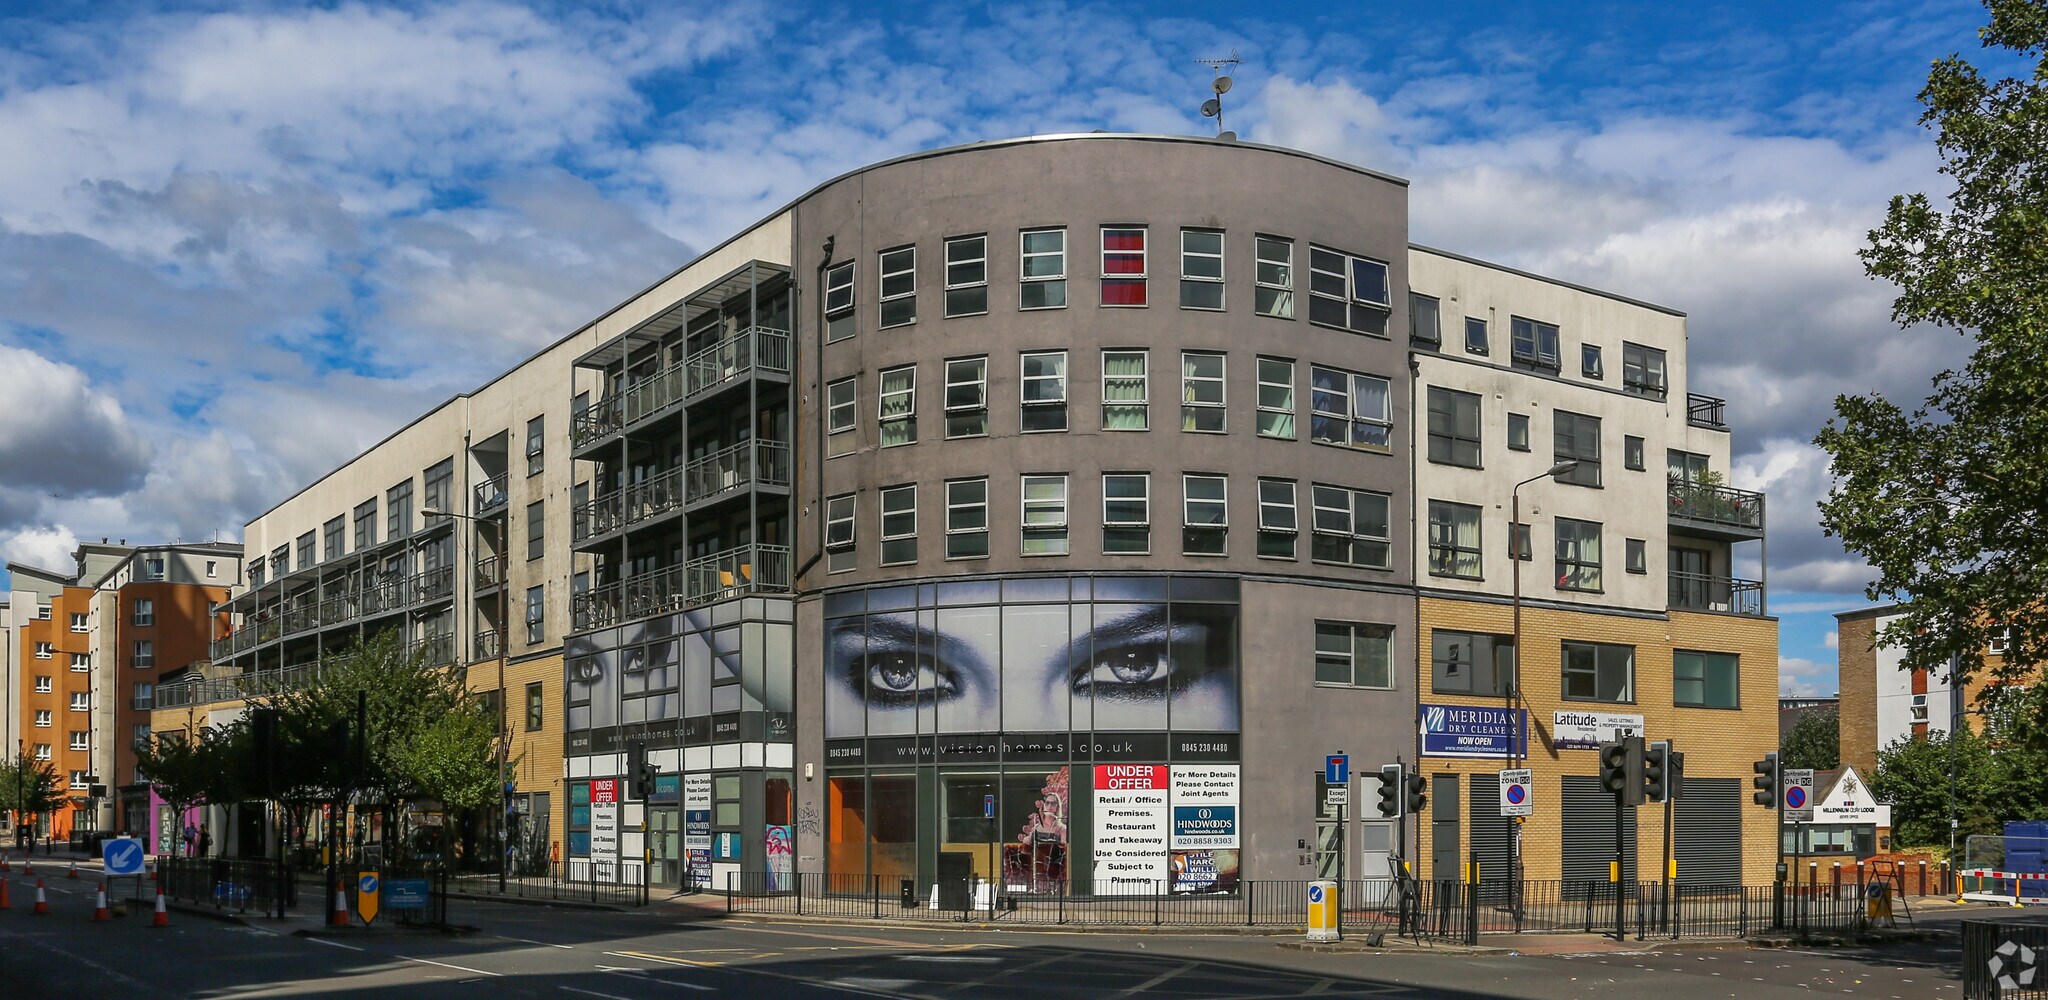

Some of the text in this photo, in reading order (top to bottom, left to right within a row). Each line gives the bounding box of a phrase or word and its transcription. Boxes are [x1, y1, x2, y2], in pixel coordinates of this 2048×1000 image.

[1449, 710, 1517, 725] MERIDIAN
[1554, 712, 1597, 727] Latitude
[608, 726, 696, 743] www.visionhomes.co.uk
[1449, 724, 1517, 735] DRY CLEANERS
[1457, 736, 1493, 746] NOW OPEN
[897, 741, 1133, 756] www.visionhomes.co.uk
[1181, 743, 1228, 752] 0845 230 4480
[829, 748, 861, 758] 0845 230 4480
[1107, 765, 1154, 777] UNDER
[595, 780, 613, 790] UNDER
[1108, 778, 1153, 790] OFFER
[596, 792, 613, 802] OFFER
[1202, 790, 1229, 798] Agents
[1099, 796, 1162, 804] Retail / Office
[1108, 809, 1153, 817] Premises.
[1177, 819, 1232, 829] HINDWOODS
[1118, 836, 1163, 844] Takeaway
[1177, 837, 1232, 845] 020 8858 9303
[1115, 849, 1166, 857] Considered
[1108, 863, 1142, 871] Subject
[1111, 876, 1151, 885] Planning
